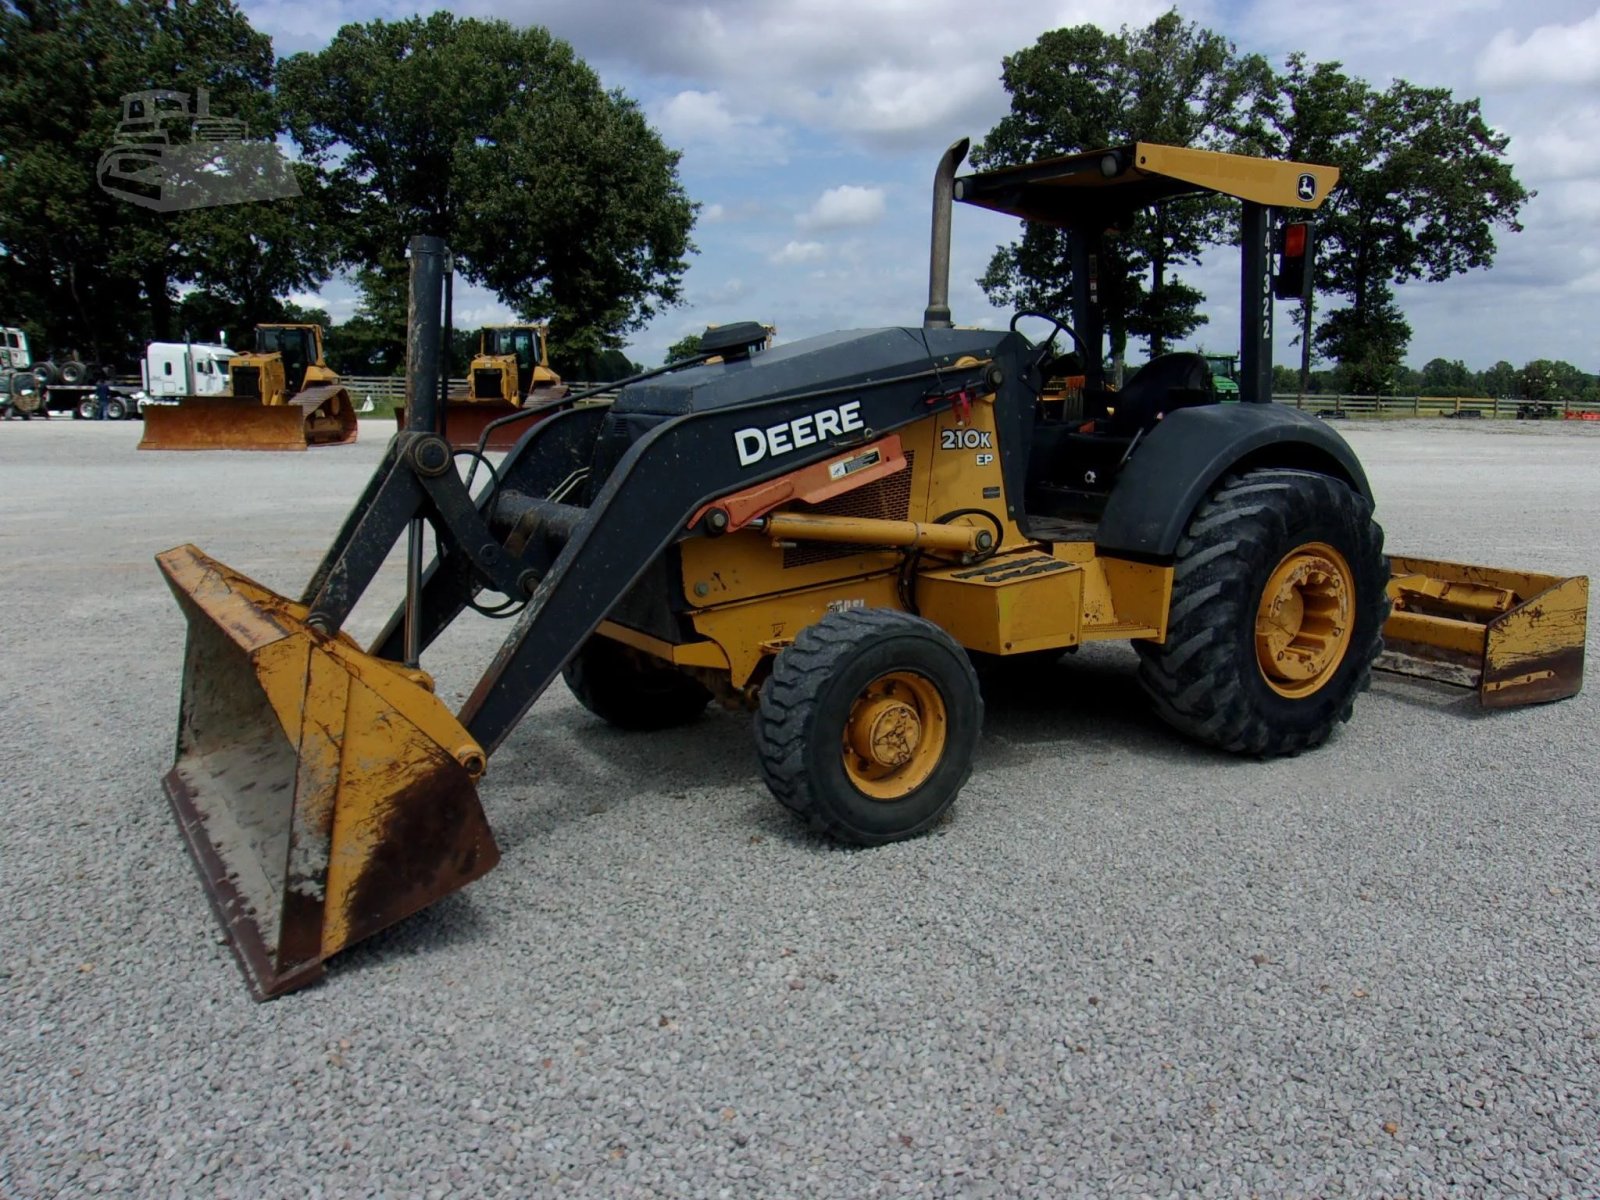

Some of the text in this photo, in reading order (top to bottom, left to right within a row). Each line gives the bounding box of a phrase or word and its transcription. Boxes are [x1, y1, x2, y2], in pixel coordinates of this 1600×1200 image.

[1263, 208, 1271, 339] 141322
[734, 400, 864, 467] DEERE
[941, 429, 992, 449] 210K
[976, 454, 993, 466] EP
